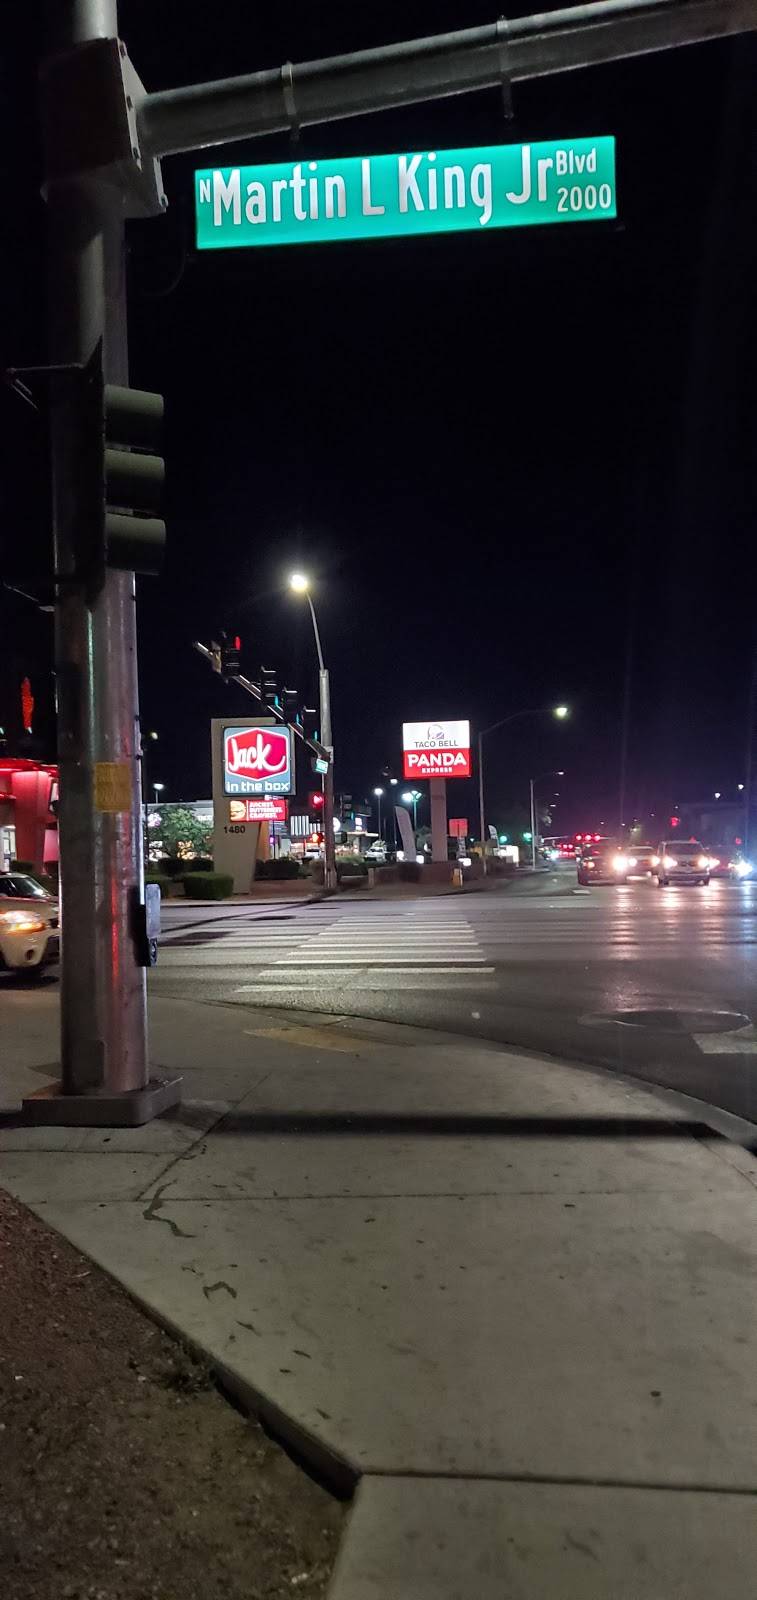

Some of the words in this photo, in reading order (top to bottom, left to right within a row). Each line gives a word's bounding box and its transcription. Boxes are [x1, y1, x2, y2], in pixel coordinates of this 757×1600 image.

[199, 179, 211, 204] N
[213, 162, 347, 227] Martin
[361, 158, 385, 216] L
[398, 152, 493, 226] King
[506, 145, 554, 205] Jr
[555, 149, 598, 176] Blvd
[557, 183, 612, 213] 2000
[414, 740, 436, 748] TACO
[438, 739, 458, 747] BELL
[228, 734, 286, 772] Jack
[407, 752, 467, 768] PANDA
[226, 781, 239, 792] in
[241, 781, 263, 792] the
[265, 781, 290, 792] box
[223, 826, 246, 834] 1480
